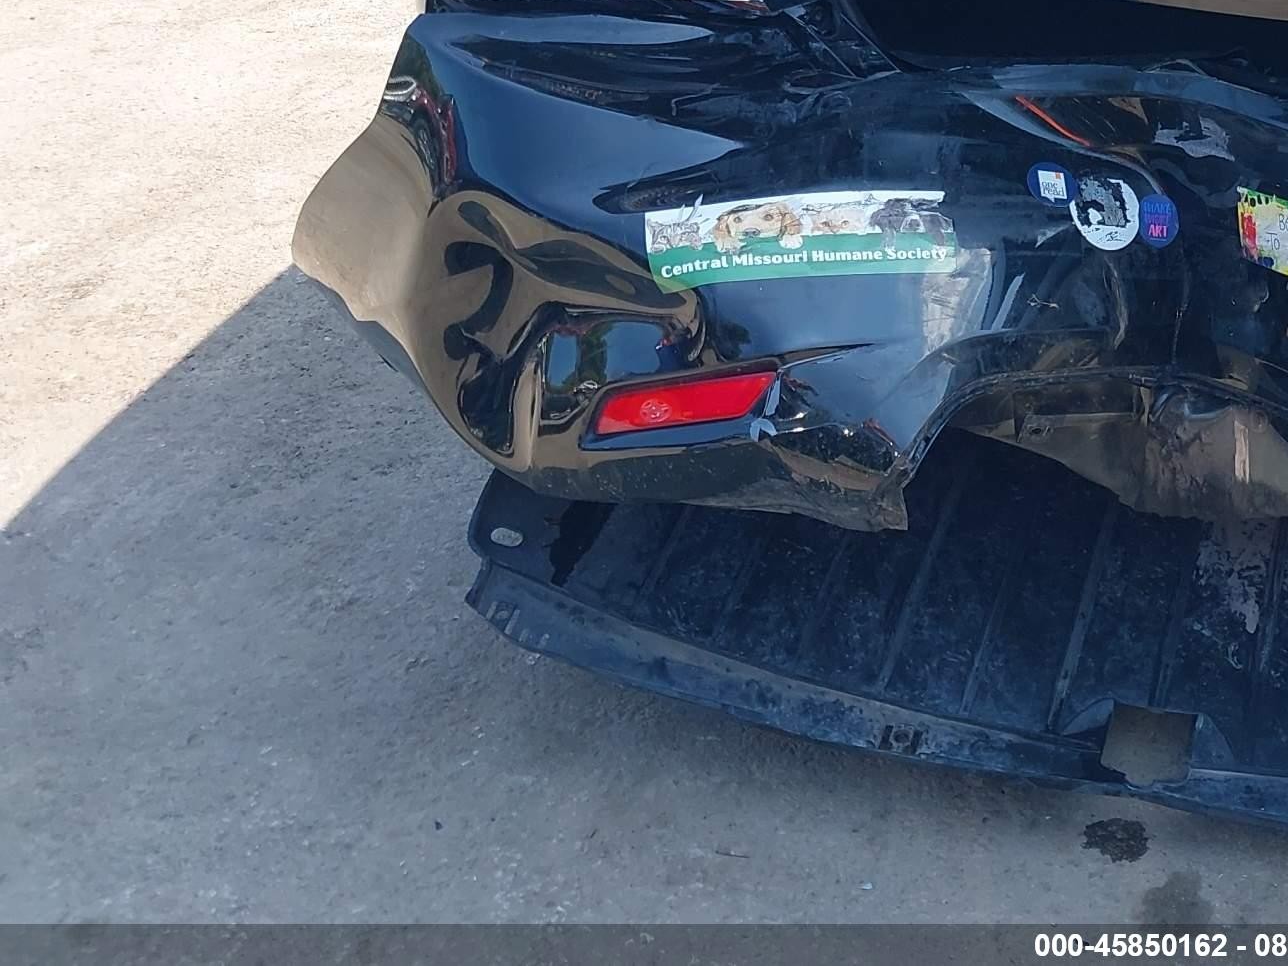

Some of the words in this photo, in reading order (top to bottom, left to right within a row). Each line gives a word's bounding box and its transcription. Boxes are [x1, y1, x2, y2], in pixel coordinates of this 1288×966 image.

[1148, 224, 1168, 238] ART
[1266, 231, 1281, 251] To
[660, 252, 729, 279] Central
[731, 249, 808, 267] Missouri
[811, 247, 883, 263] Humane
[886, 246, 948, 263] Society
